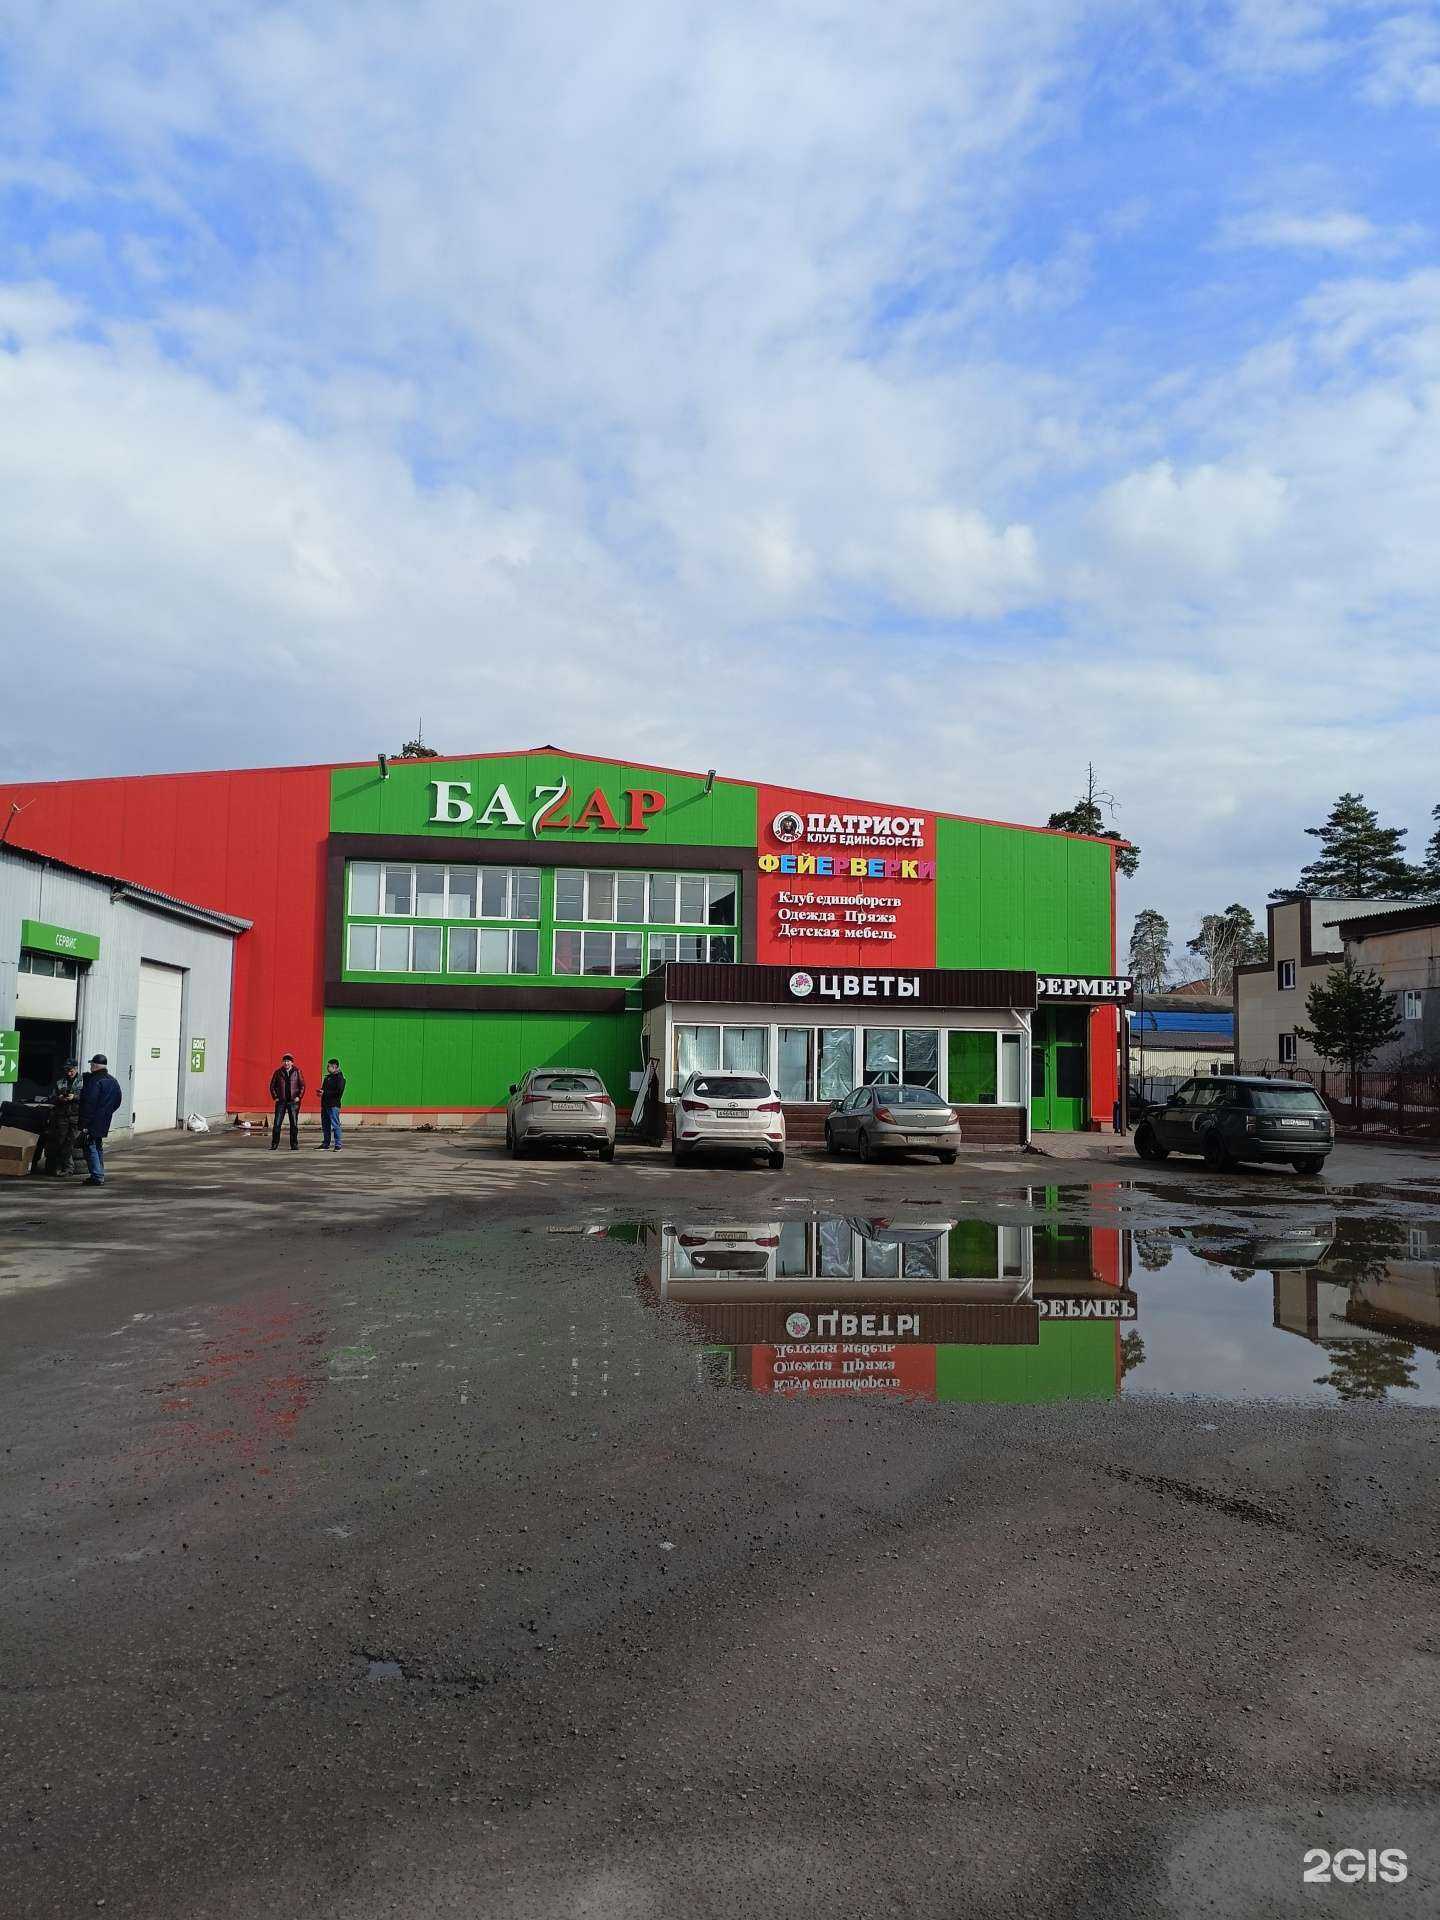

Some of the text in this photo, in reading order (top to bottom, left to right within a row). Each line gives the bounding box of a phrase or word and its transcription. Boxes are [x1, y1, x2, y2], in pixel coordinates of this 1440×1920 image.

[807, 813, 925, 837] ПАТРИОТ
[807, 833, 925, 847] КЛУБ ЕДИНОБОРСТВ
[758, 852, 936, 880] ФЕЙЕРВЕРКИ
[778, 891, 902, 908] Клуб единоборств
[778, 908, 897, 924] Одежда Пряжа
[778, 924, 897, 940] Детская мебель
[55, 934, 77, 949] СЕРВИС
[818, 976, 920, 1000] ЦВЕТЫ
[195, 1053, 200, 1069] 3
